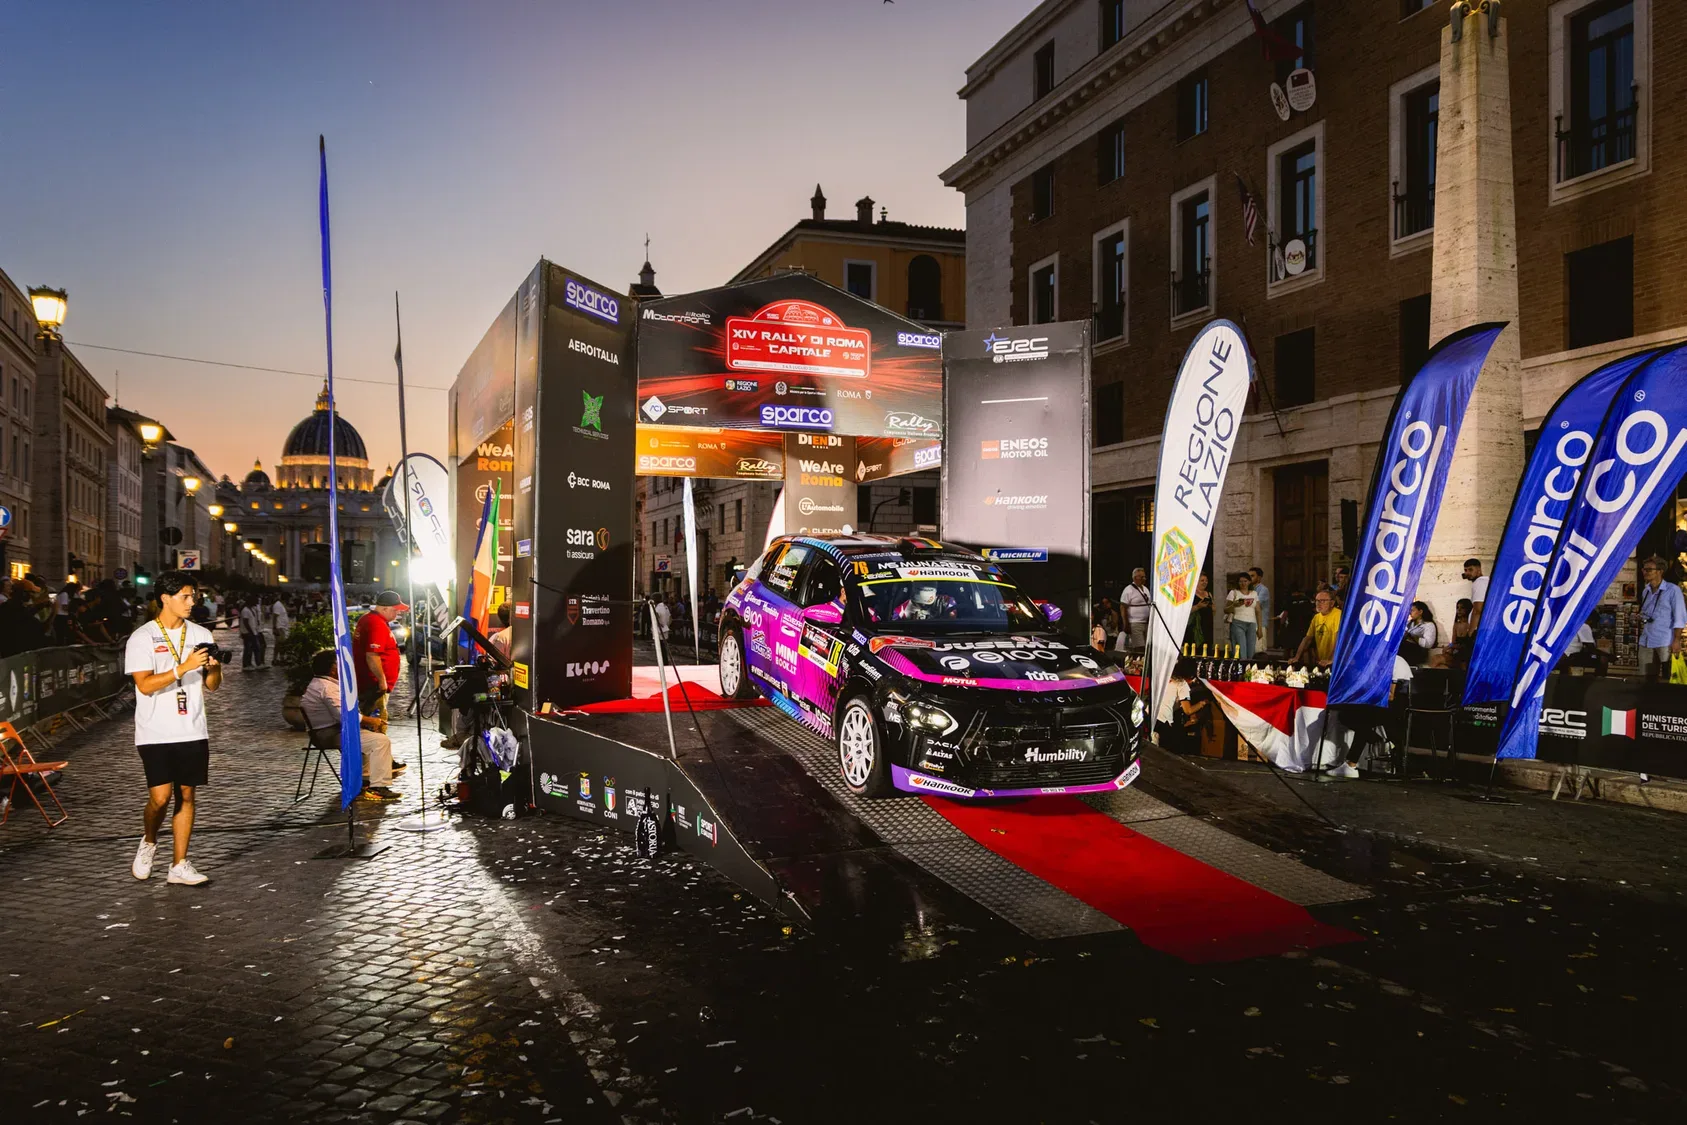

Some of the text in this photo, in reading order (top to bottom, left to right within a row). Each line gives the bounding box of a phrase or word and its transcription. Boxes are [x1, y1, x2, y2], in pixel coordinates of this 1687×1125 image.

[566, 282, 618, 317] sparco
[732, 329, 864, 348] XIV RALLY DI ROMA
[898, 333, 940, 346] sparco
[568, 338, 618, 364] AEROITALIA
[769, 344, 832, 358] CAPITALE
[993, 338, 1048, 354] ERC
[837, 390, 861, 399] ROMA
[668, 406, 708, 414] SPORT
[762, 406, 832, 425] sparco
[889, 416, 933, 432] Rally
[1174, 336, 1232, 509] REGIONE
[798, 434, 842, 446] DIENDI
[1000, 438, 1048, 450] ENEOS
[1001, 450, 1048, 459] MOTOR OIL
[640, 456, 694, 470] sparco
[740, 461, 776, 472] Rally
[799, 460, 844, 473] WeAre
[1192, 408, 1234, 526] LAZIO
[577, 477, 610, 490] BCC ROMA
[800, 473, 843, 487] Roma
[802, 502, 844, 512] L'Automobile
[1360, 420, 1432, 636] sparco
[1503, 430, 1594, 634] sparco
[566, 528, 594, 546] sara
[572, 550, 594, 560] assicura
[851, 562, 869, 575] 76
[900, 561, 982, 571] MUNARETTO
[582, 606, 610, 614] Travertino
[582, 617, 604, 625] Romano
[776, 641, 798, 666] MINI
[1642, 722, 1659, 730] DEL
[1642, 732, 1675, 740] REPUBBLICA
[932, 751, 953, 759] ALTAS
[1024, 747, 1087, 762] Humbility
[604, 811, 617, 820] CONI
[647, 818, 657, 858] ASTORIA
